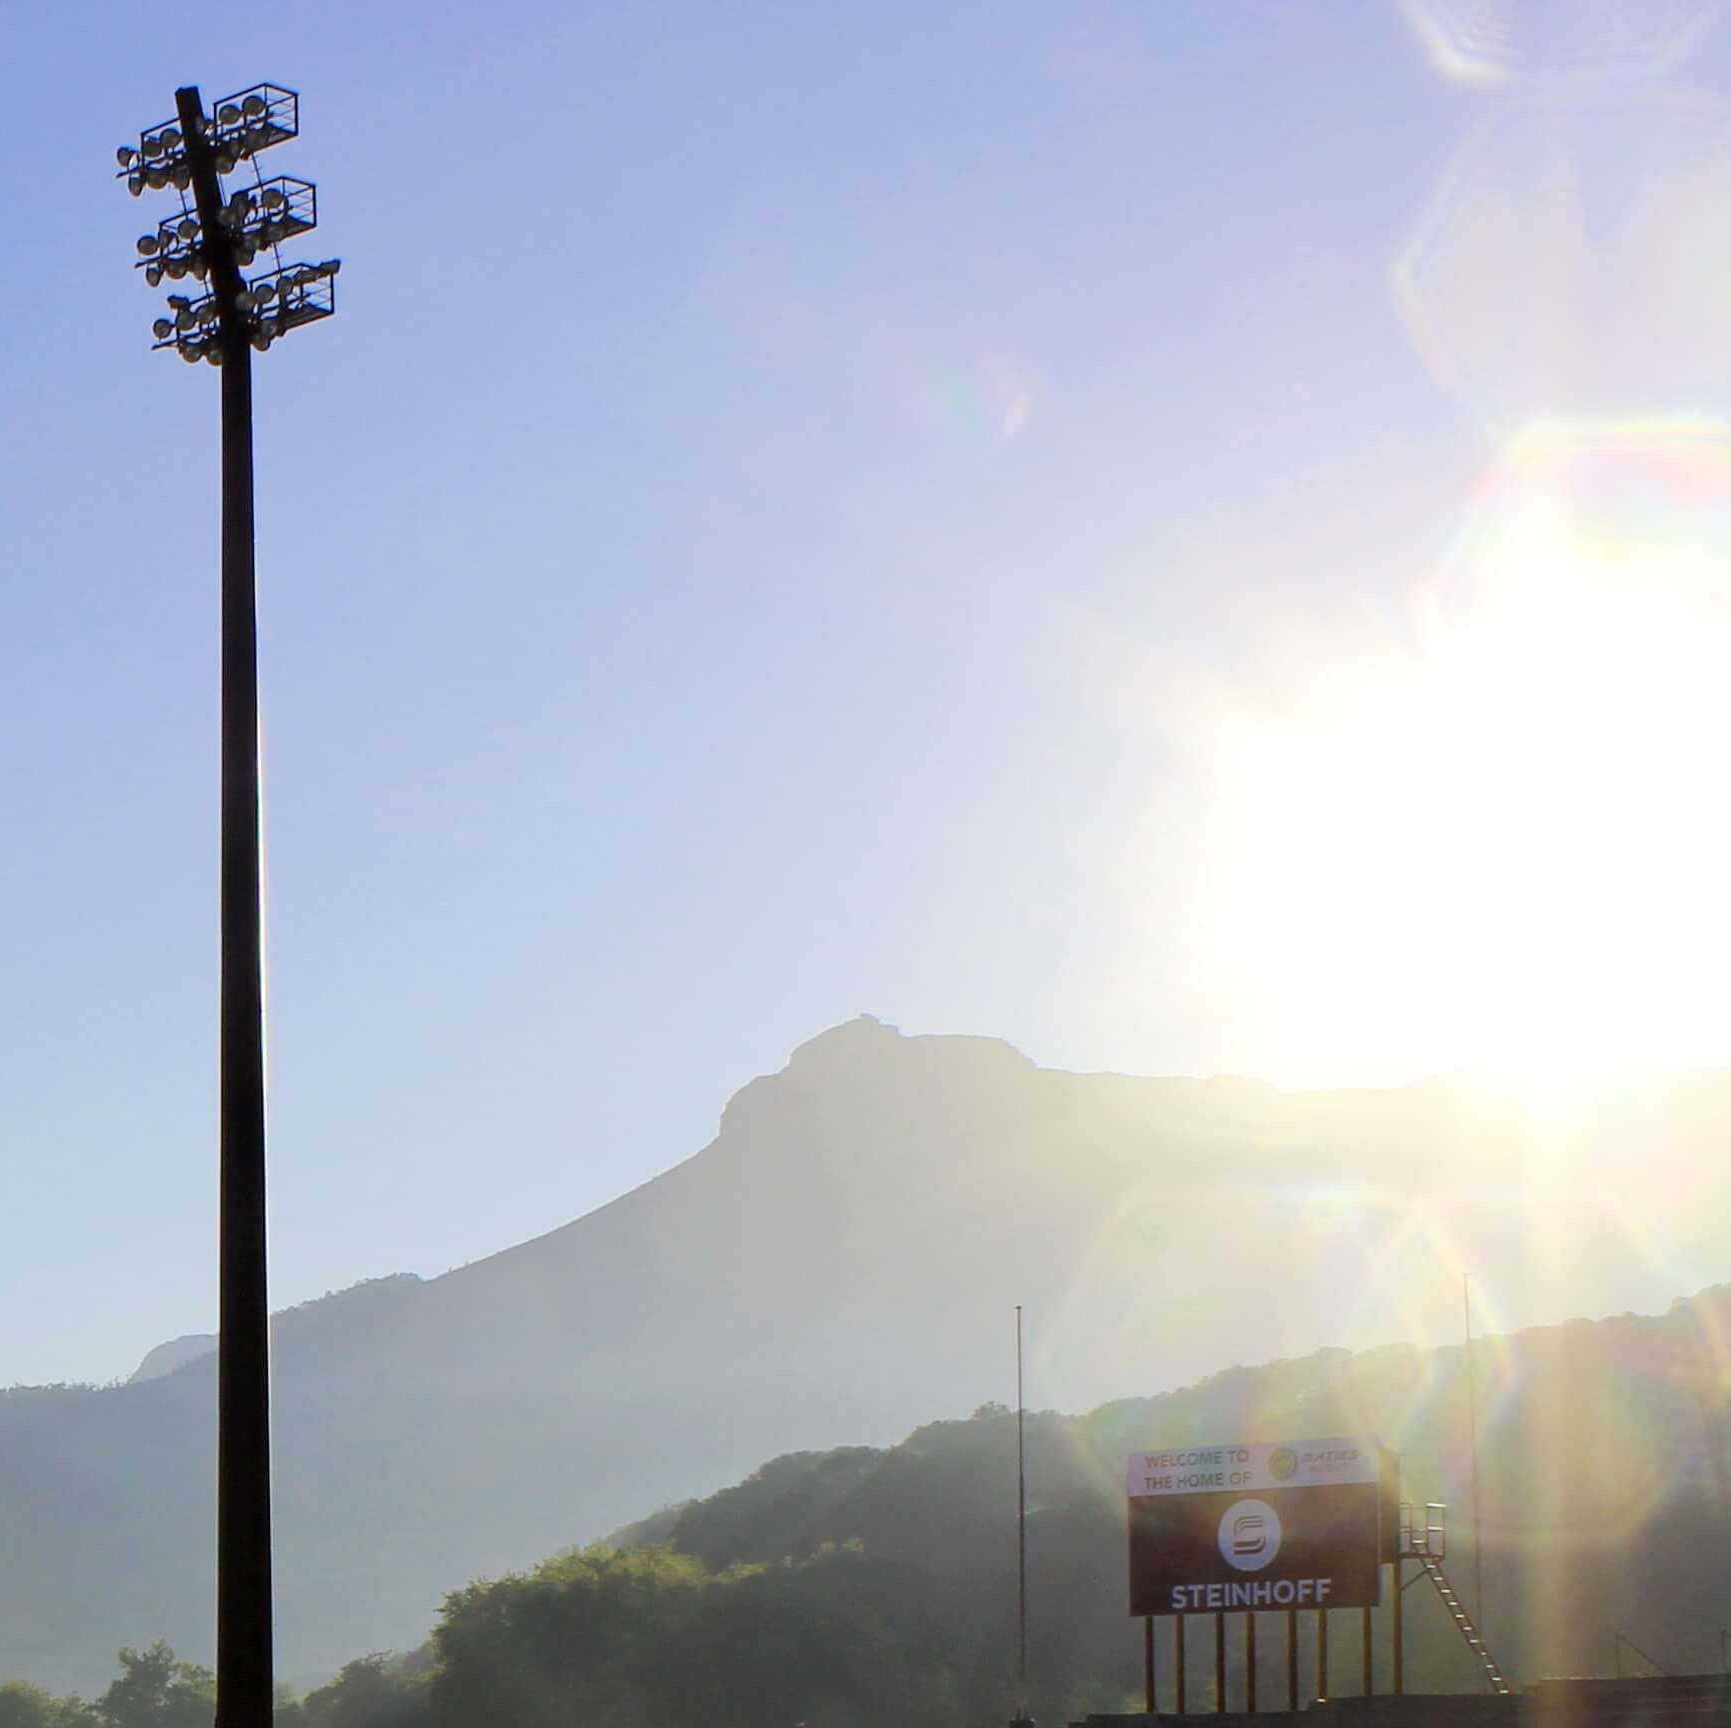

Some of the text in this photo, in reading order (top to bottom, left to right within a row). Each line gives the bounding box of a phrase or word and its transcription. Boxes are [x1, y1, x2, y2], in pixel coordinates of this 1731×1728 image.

[1144, 1449, 1249, 1468] WELCOME TO
[1144, 1471, 1252, 1490] THE HOME OF
[1171, 1578, 1333, 1610] STEINHOFF
